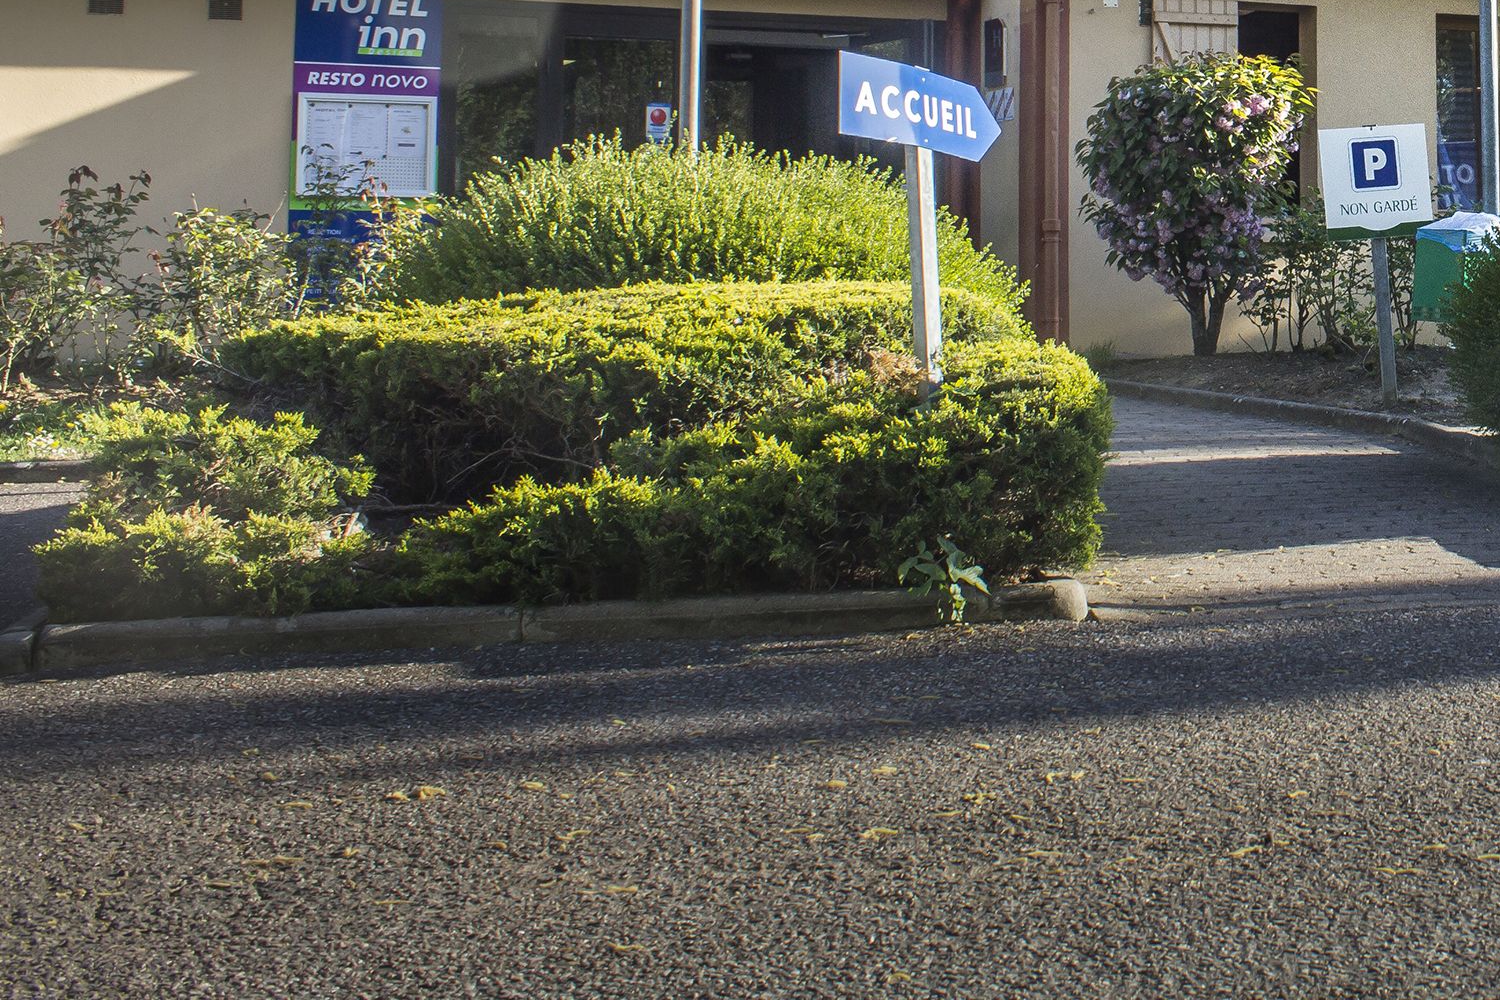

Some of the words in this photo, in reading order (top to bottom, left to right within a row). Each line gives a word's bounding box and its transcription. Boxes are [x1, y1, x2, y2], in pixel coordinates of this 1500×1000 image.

[358, 15, 426, 49] inn
[307, 71, 366, 86] RESTO
[371, 74, 428, 89] novo
[854, 81, 977, 139] ACCUEIL
[1363, 147, 1387, 181] P
[1437, 163, 1475, 184] TO
[1340, 203, 1368, 216] NON
[1373, 195, 1418, 214] GARDÉ
